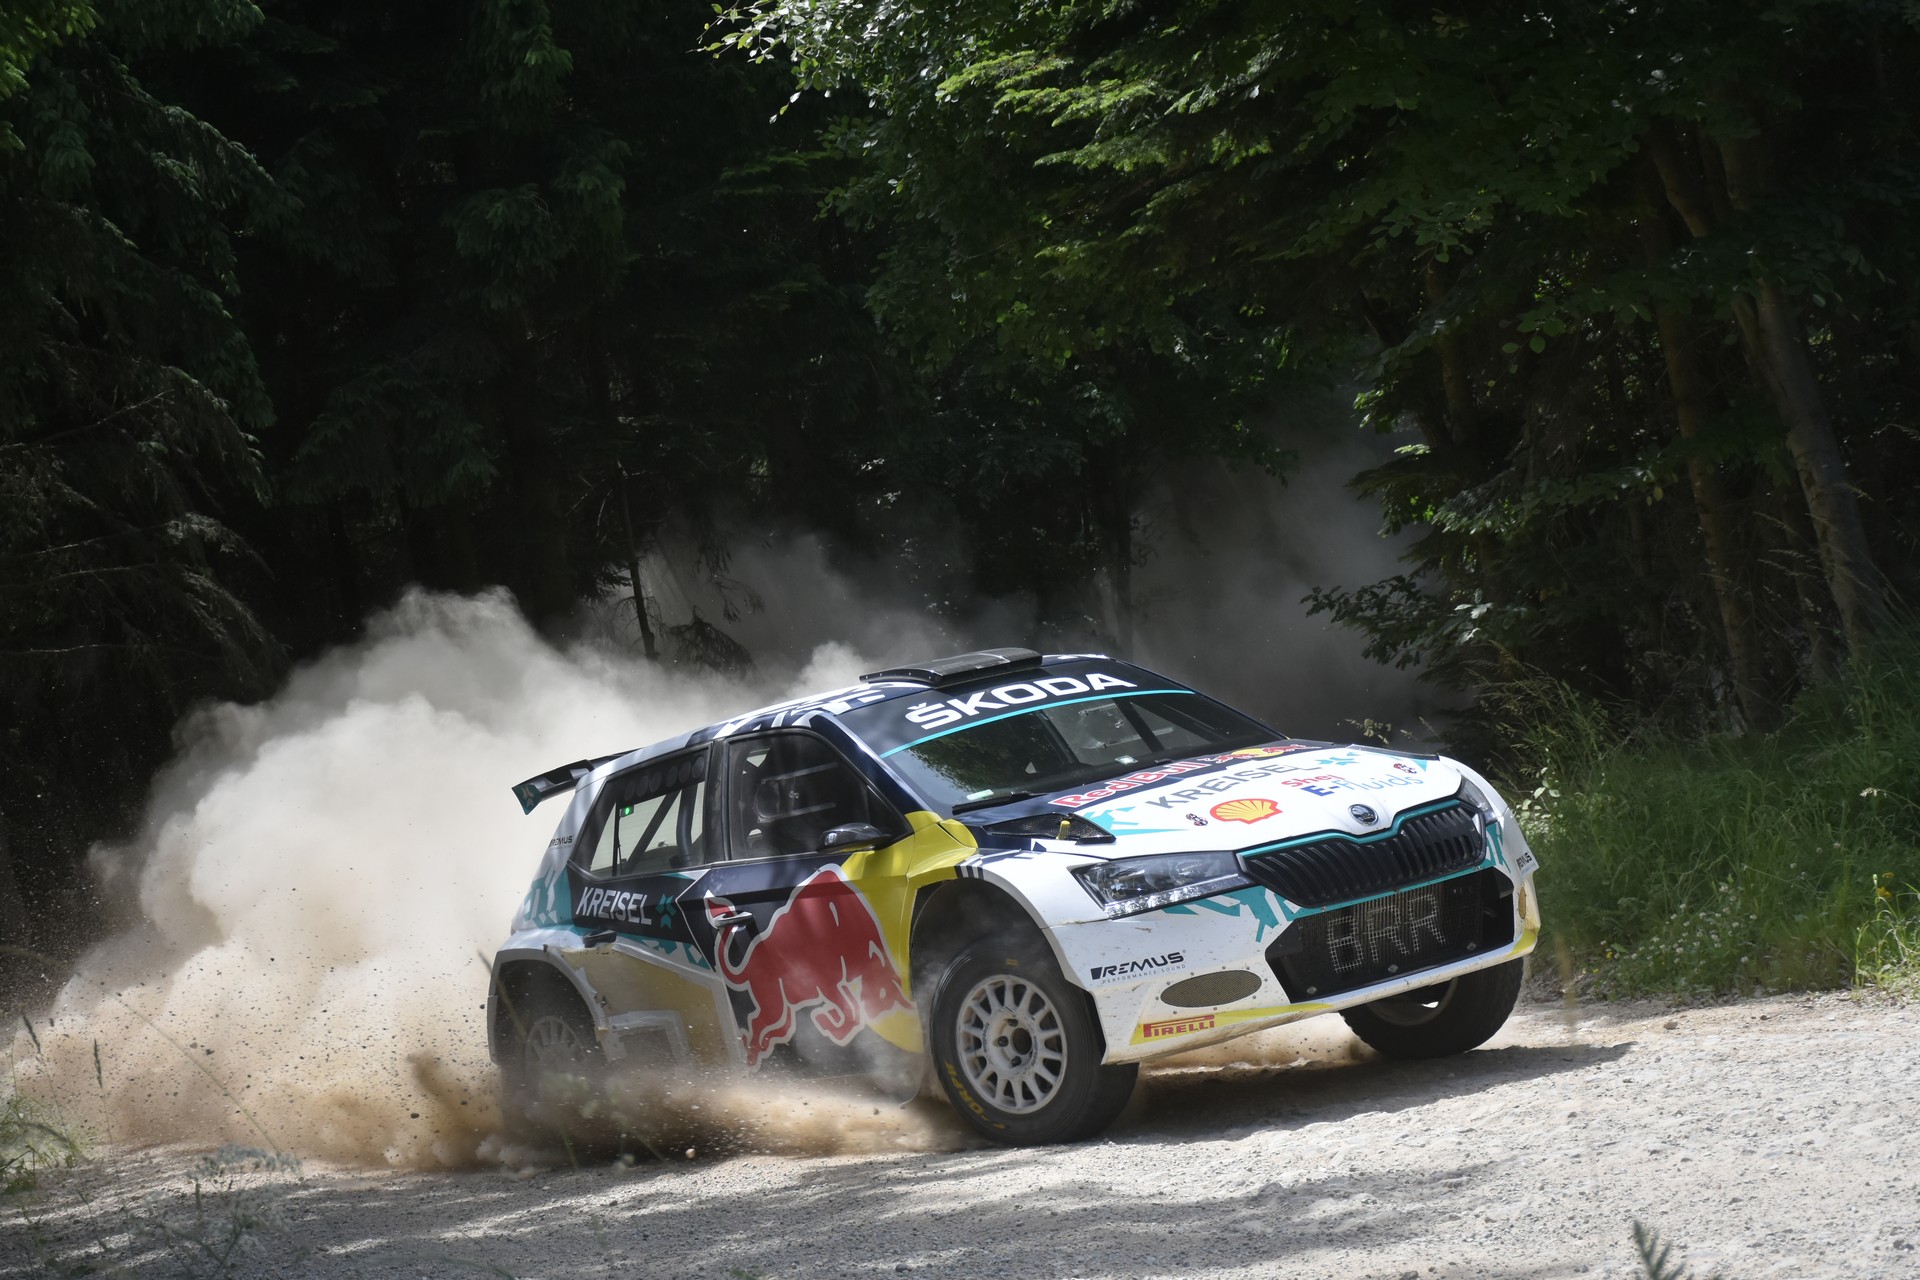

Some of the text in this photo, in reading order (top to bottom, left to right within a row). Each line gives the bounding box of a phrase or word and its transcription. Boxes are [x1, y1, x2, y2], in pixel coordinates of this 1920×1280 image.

[905, 672, 1137, 730] ŠKODA
[1048, 761, 1212, 809] Red Bull
[1144, 764, 1323, 809] KREISEL
[575, 886, 652, 926] KREISEL
[1099, 951, 1185, 978] REMUS
[1143, 1014, 1216, 1039] PIRELLI
